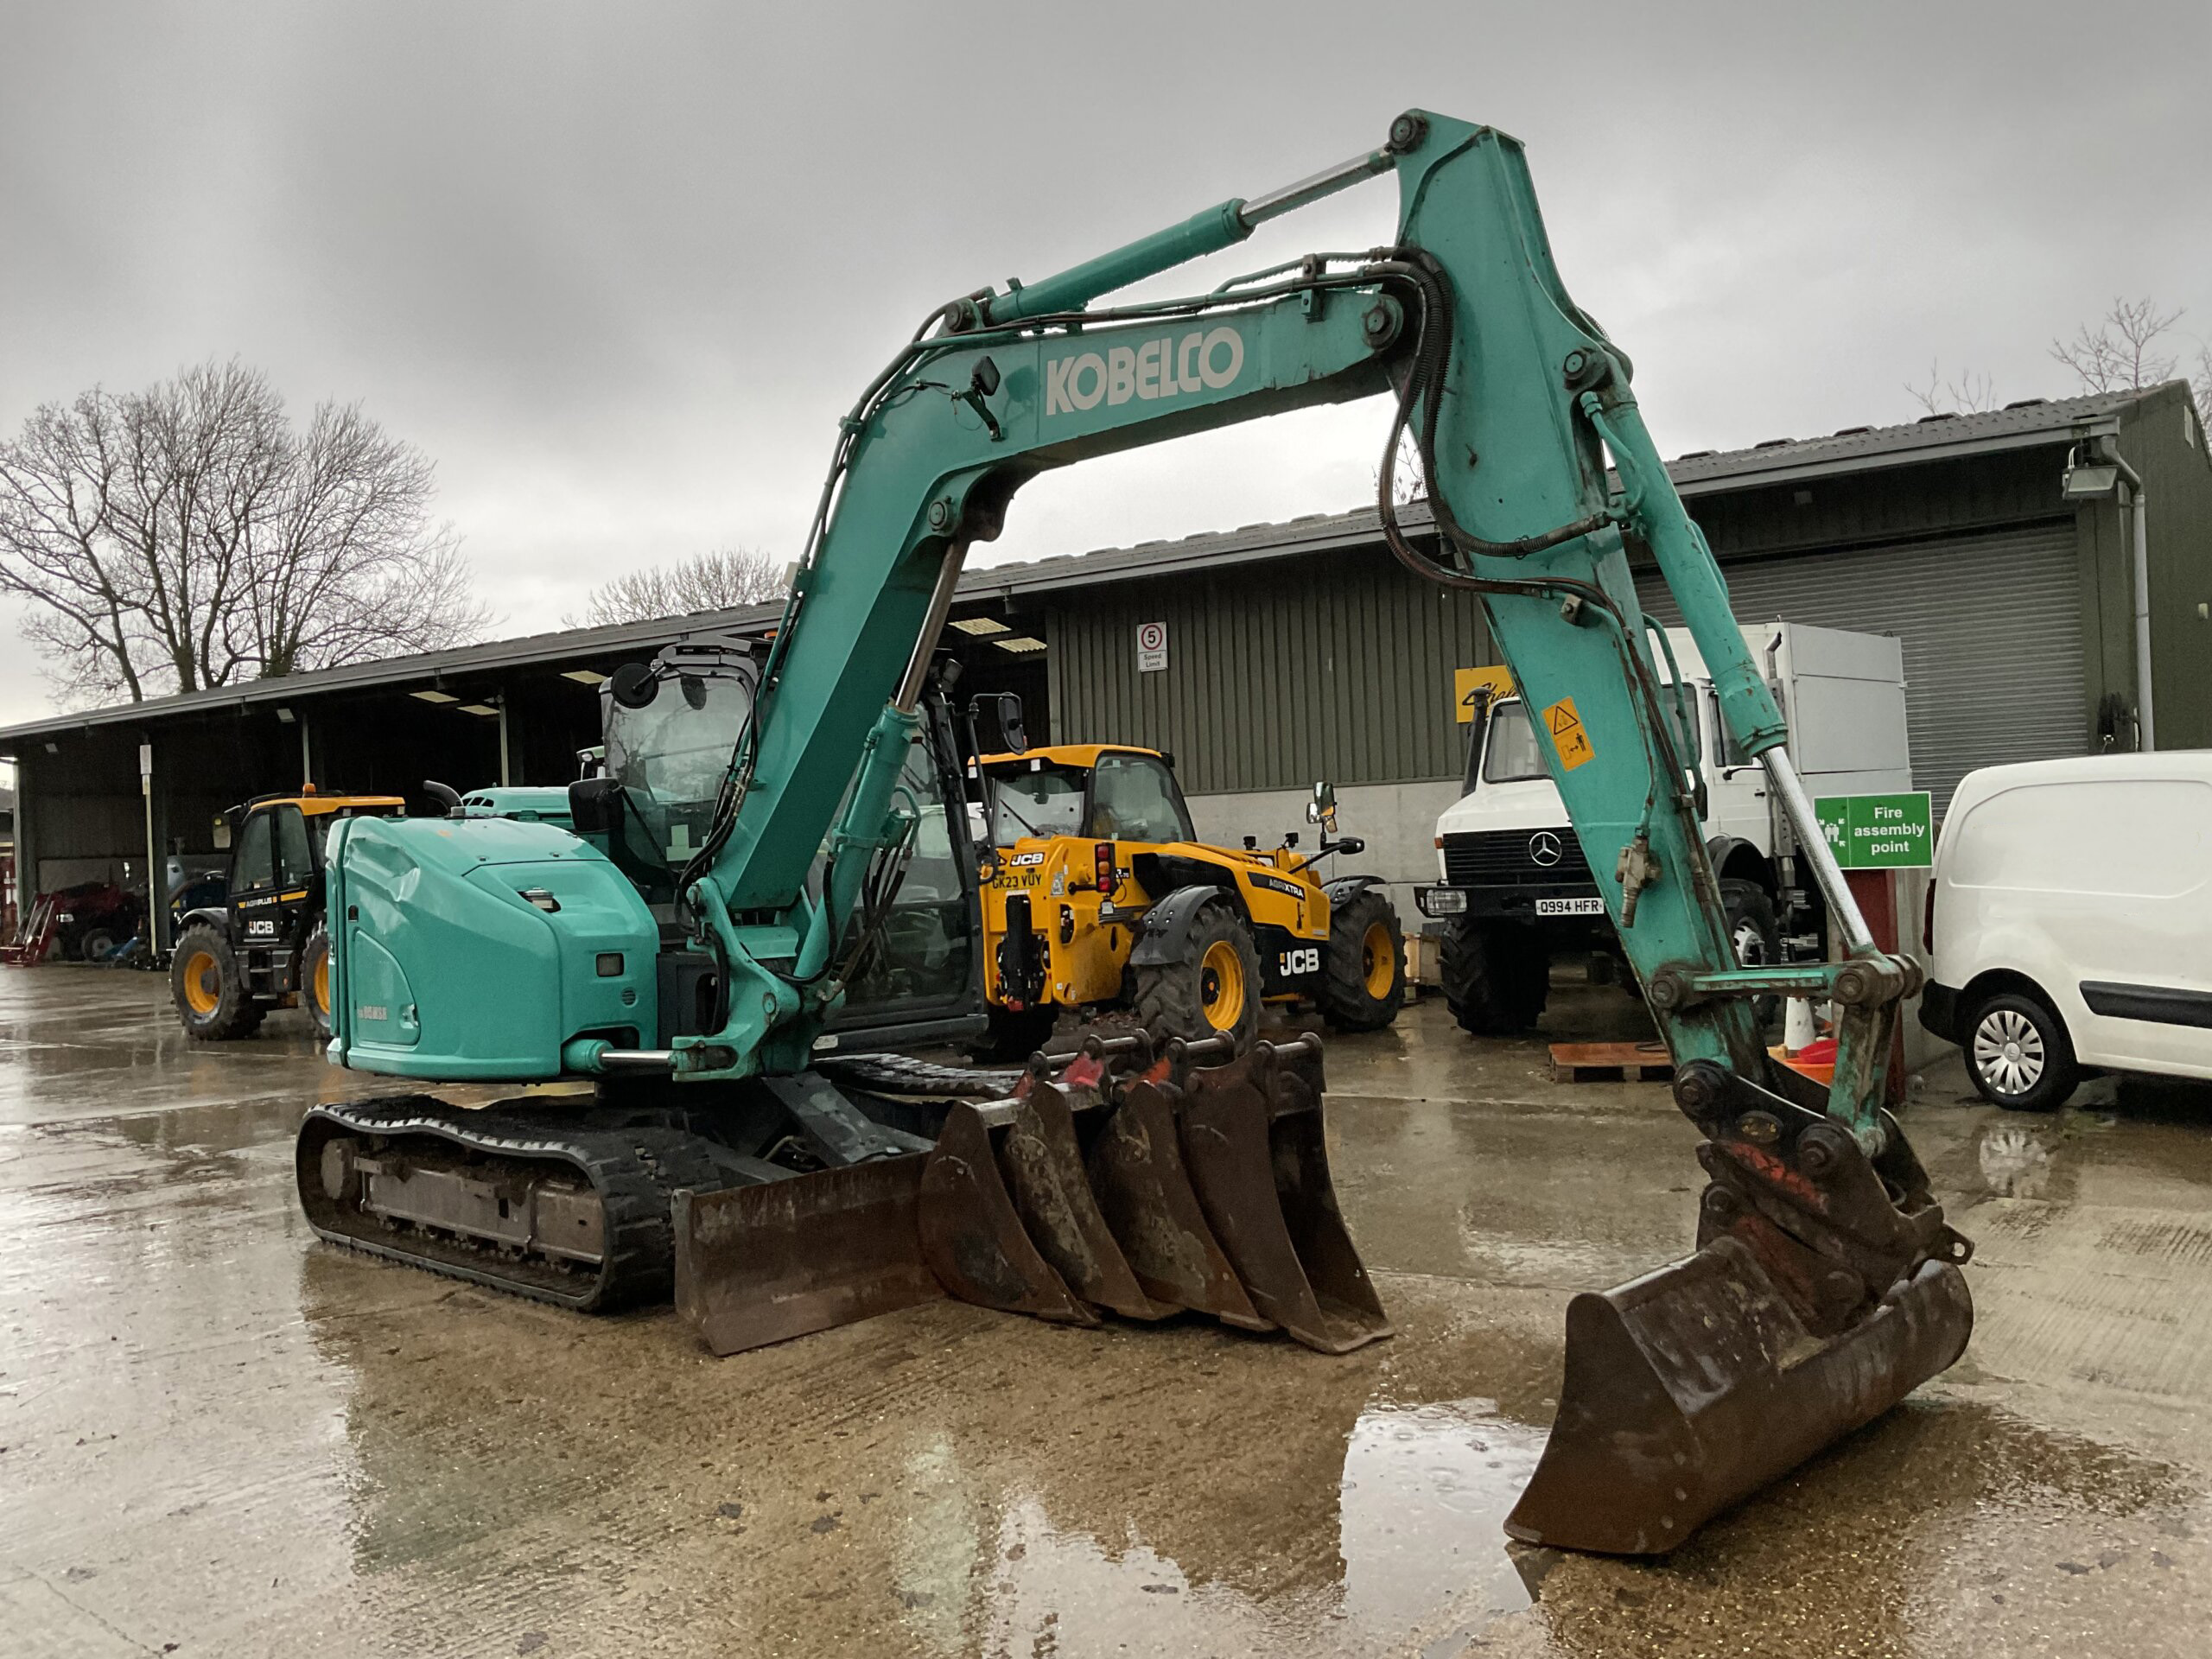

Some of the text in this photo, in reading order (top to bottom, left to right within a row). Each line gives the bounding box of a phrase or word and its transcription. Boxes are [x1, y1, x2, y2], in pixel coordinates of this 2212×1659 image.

[1046, 327, 1244, 416] KOBELCO
[1147, 631, 1156, 644] 5
[1874, 807, 1903, 819] Fire
[1853, 823, 1925, 837] assembly
[1871, 841, 1910, 855] point
[1011, 853, 1044, 866] JCB
[992, 874, 1041, 889] GK23 VUY
[1541, 899, 1599, 913] Q994 HFR
[249, 920, 274, 934] JCB
[1280, 948, 1319, 976] JCB
